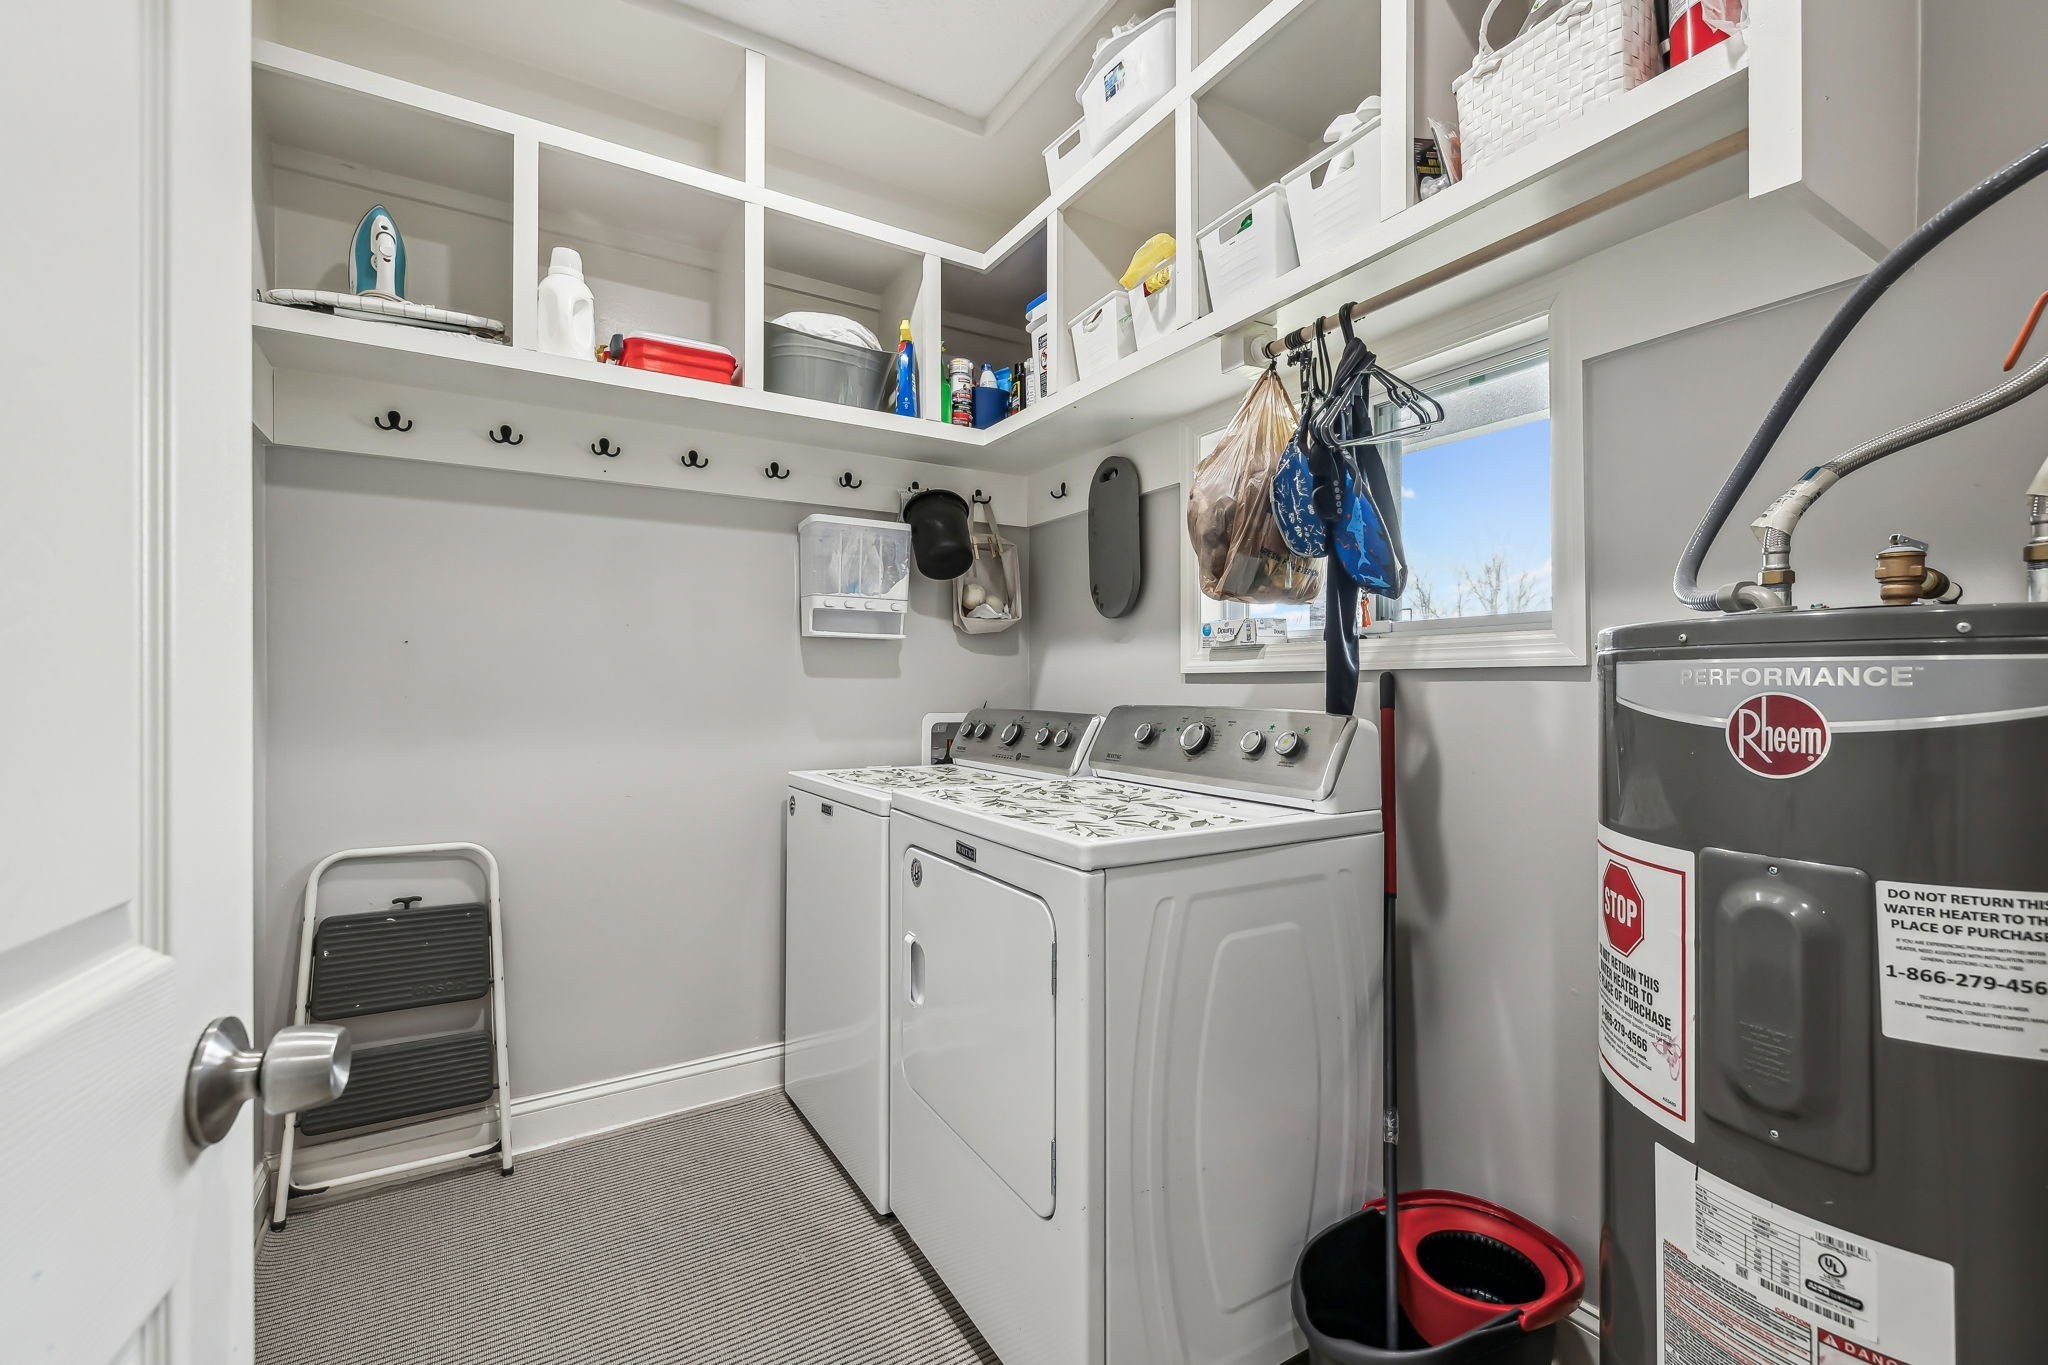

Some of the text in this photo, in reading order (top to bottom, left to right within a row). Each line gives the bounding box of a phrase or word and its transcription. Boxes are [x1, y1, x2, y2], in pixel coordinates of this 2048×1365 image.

[1217, 627, 1235, 636] Downy
[1273, 628, 1286, 636] Downy
[1738, 696, 1823, 764] Rheem
[1604, 886, 1638, 927] STOP
[1887, 888, 1911, 900] DO
[1914, 891, 1946, 903] NOT
[1951, 894, 2014, 909] RETURN
[1884, 903, 1936, 918] WATER
[1939, 908, 2000, 923] HEATER
[2003, 914, 2024, 925] TO
[1891, 919, 1939, 934] PLACE
[1942, 924, 1963, 936] OF
[1611, 955, 1636, 982] RETURN
[1638, 971, 1660, 993] THIS
[1613, 971, 1639, 999] HEATER
[1641, 989, 1653, 1006] TO
[1614, 987, 1623, 1003] OF
[1624, 994, 1672, 1032] PURCHASE
[1824, 1256, 1840, 1275] UL
[1774, 1307, 1812, 1328] CAUTION
